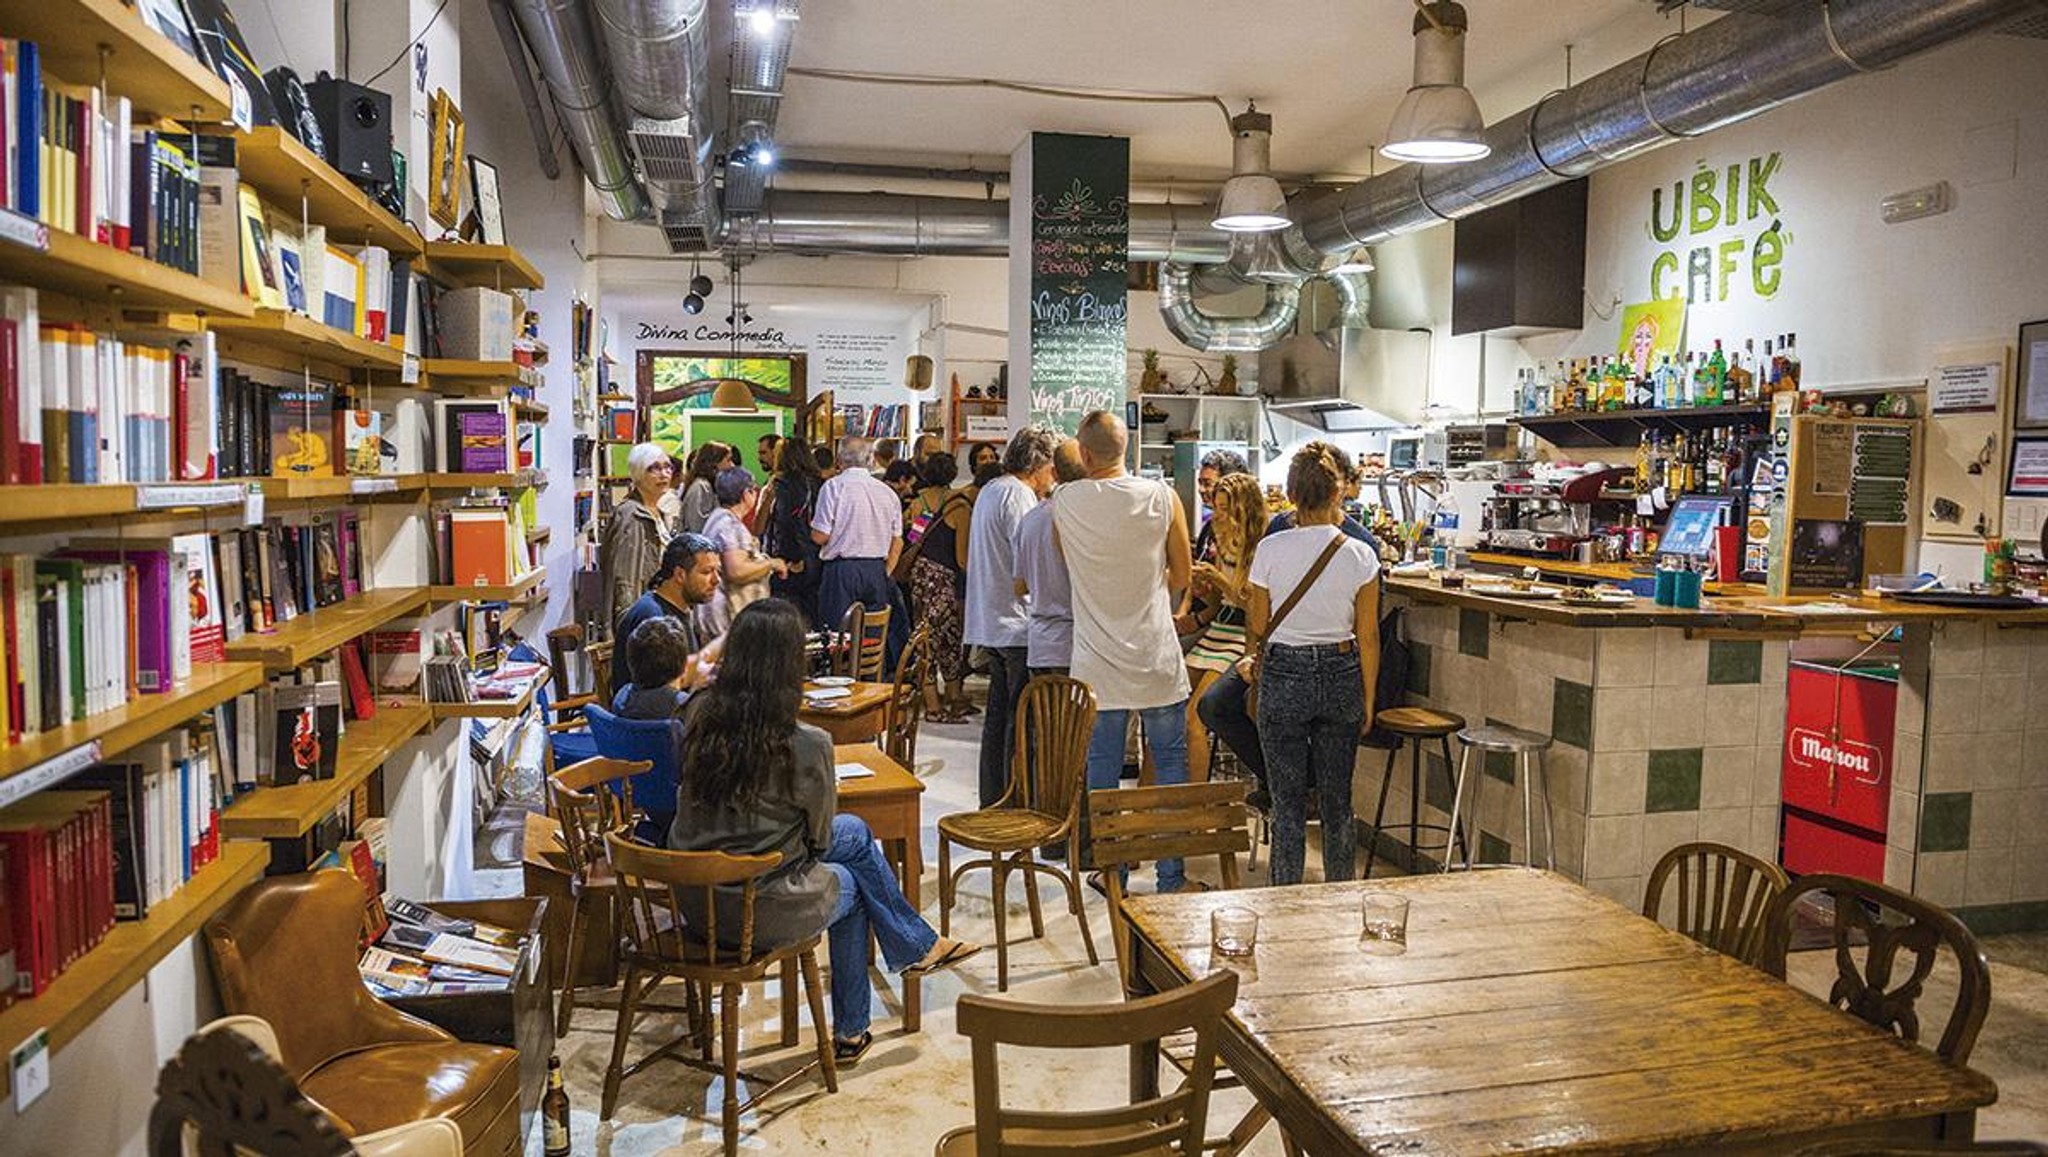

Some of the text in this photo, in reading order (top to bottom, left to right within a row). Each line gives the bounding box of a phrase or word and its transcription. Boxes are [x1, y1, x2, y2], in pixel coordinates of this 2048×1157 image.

[1652, 152, 1781, 242] UBIK
[1032, 290, 1071, 325] Vinos
[635, 322, 786, 343] Divina Commedia
